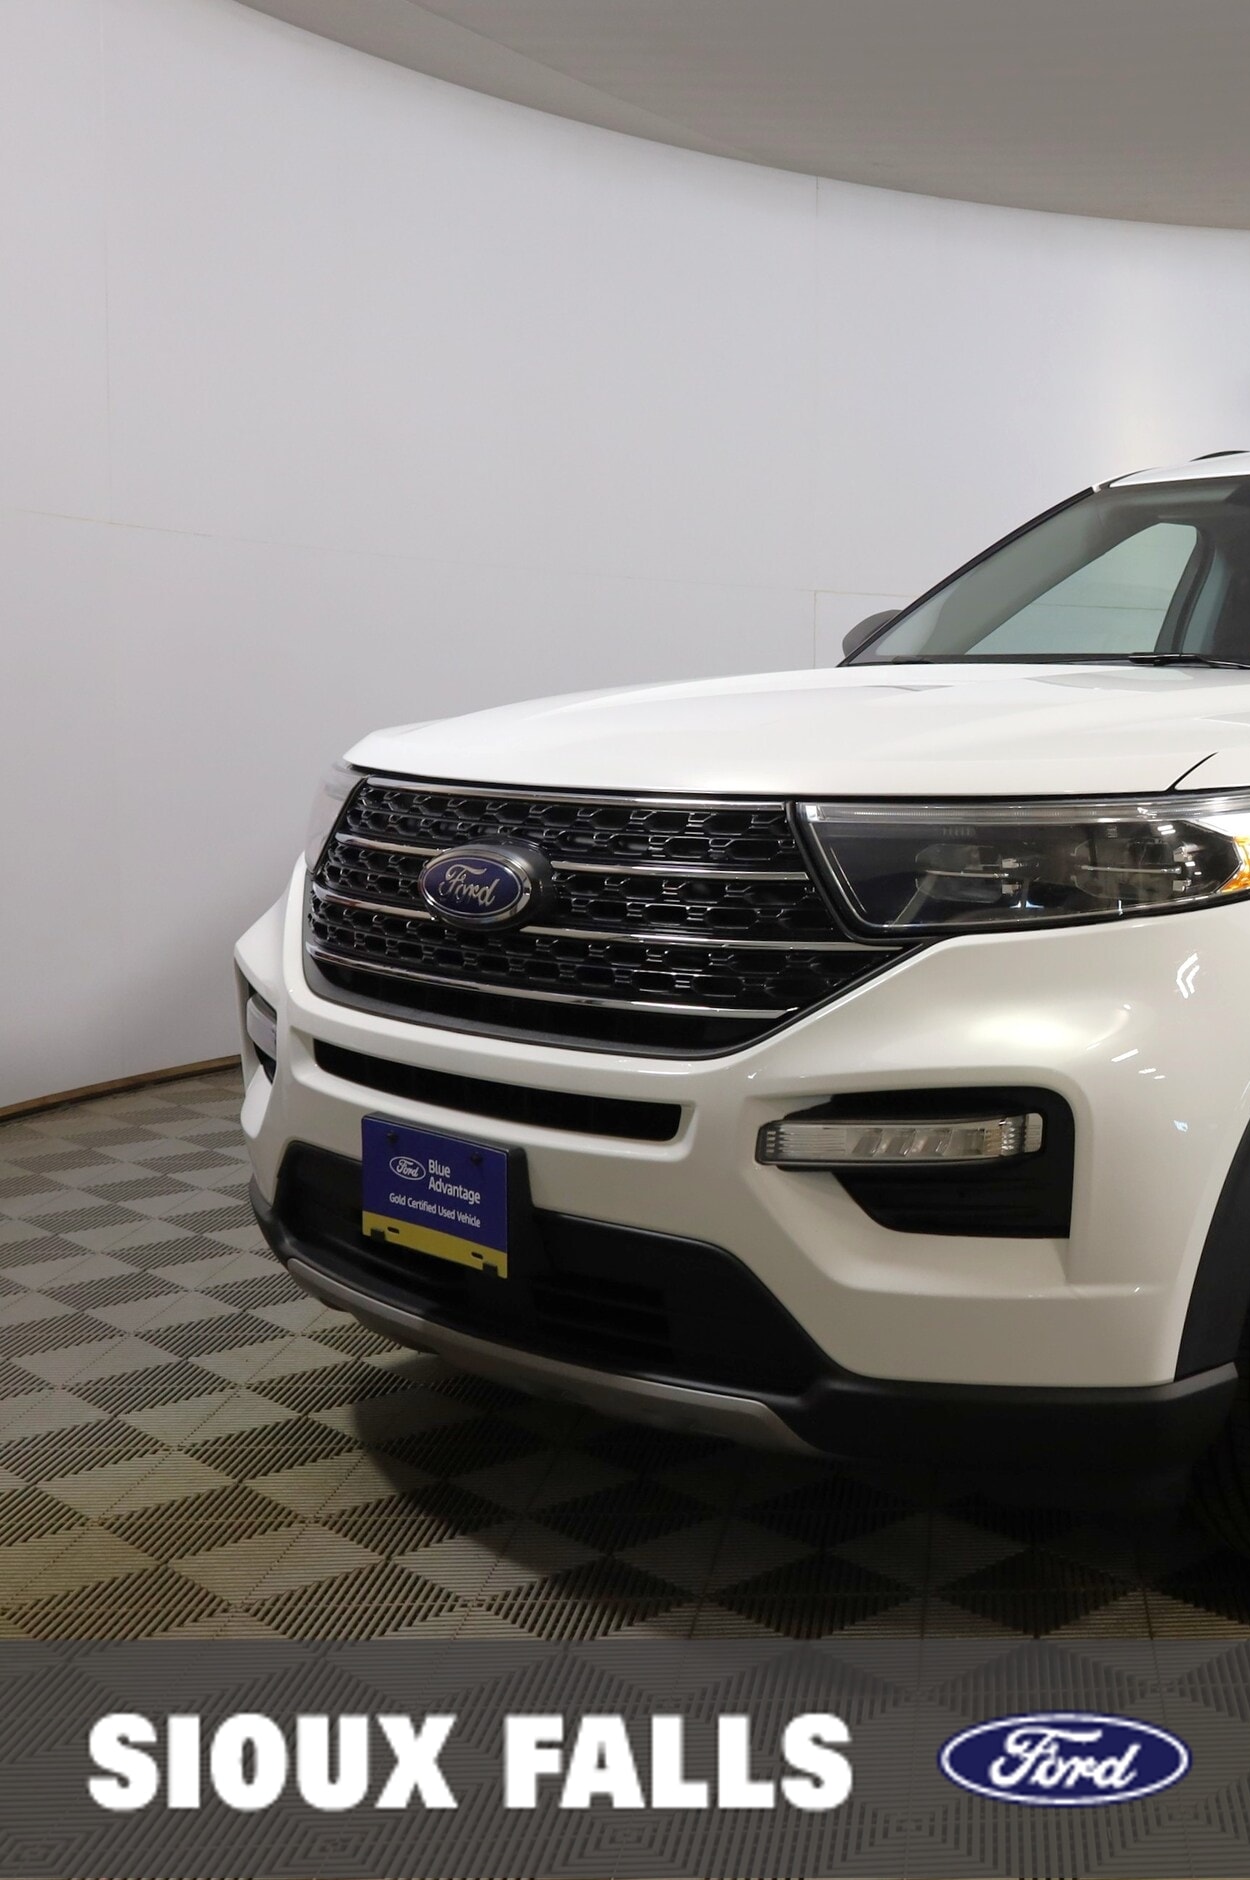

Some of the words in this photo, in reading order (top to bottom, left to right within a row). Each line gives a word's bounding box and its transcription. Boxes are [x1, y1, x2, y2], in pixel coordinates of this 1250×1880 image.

[438, 864, 500, 907] Ford
[396, 1159, 419, 1177] Ford
[428, 1159, 451, 1177] Blue
[428, 1176, 481, 1205] Advantage
[389, 1192, 406, 1206] Gold
[407, 1197, 437, 1214] Certified
[438, 1205, 456, 1220] Used
[457, 1210, 481, 1228] Vehicle
